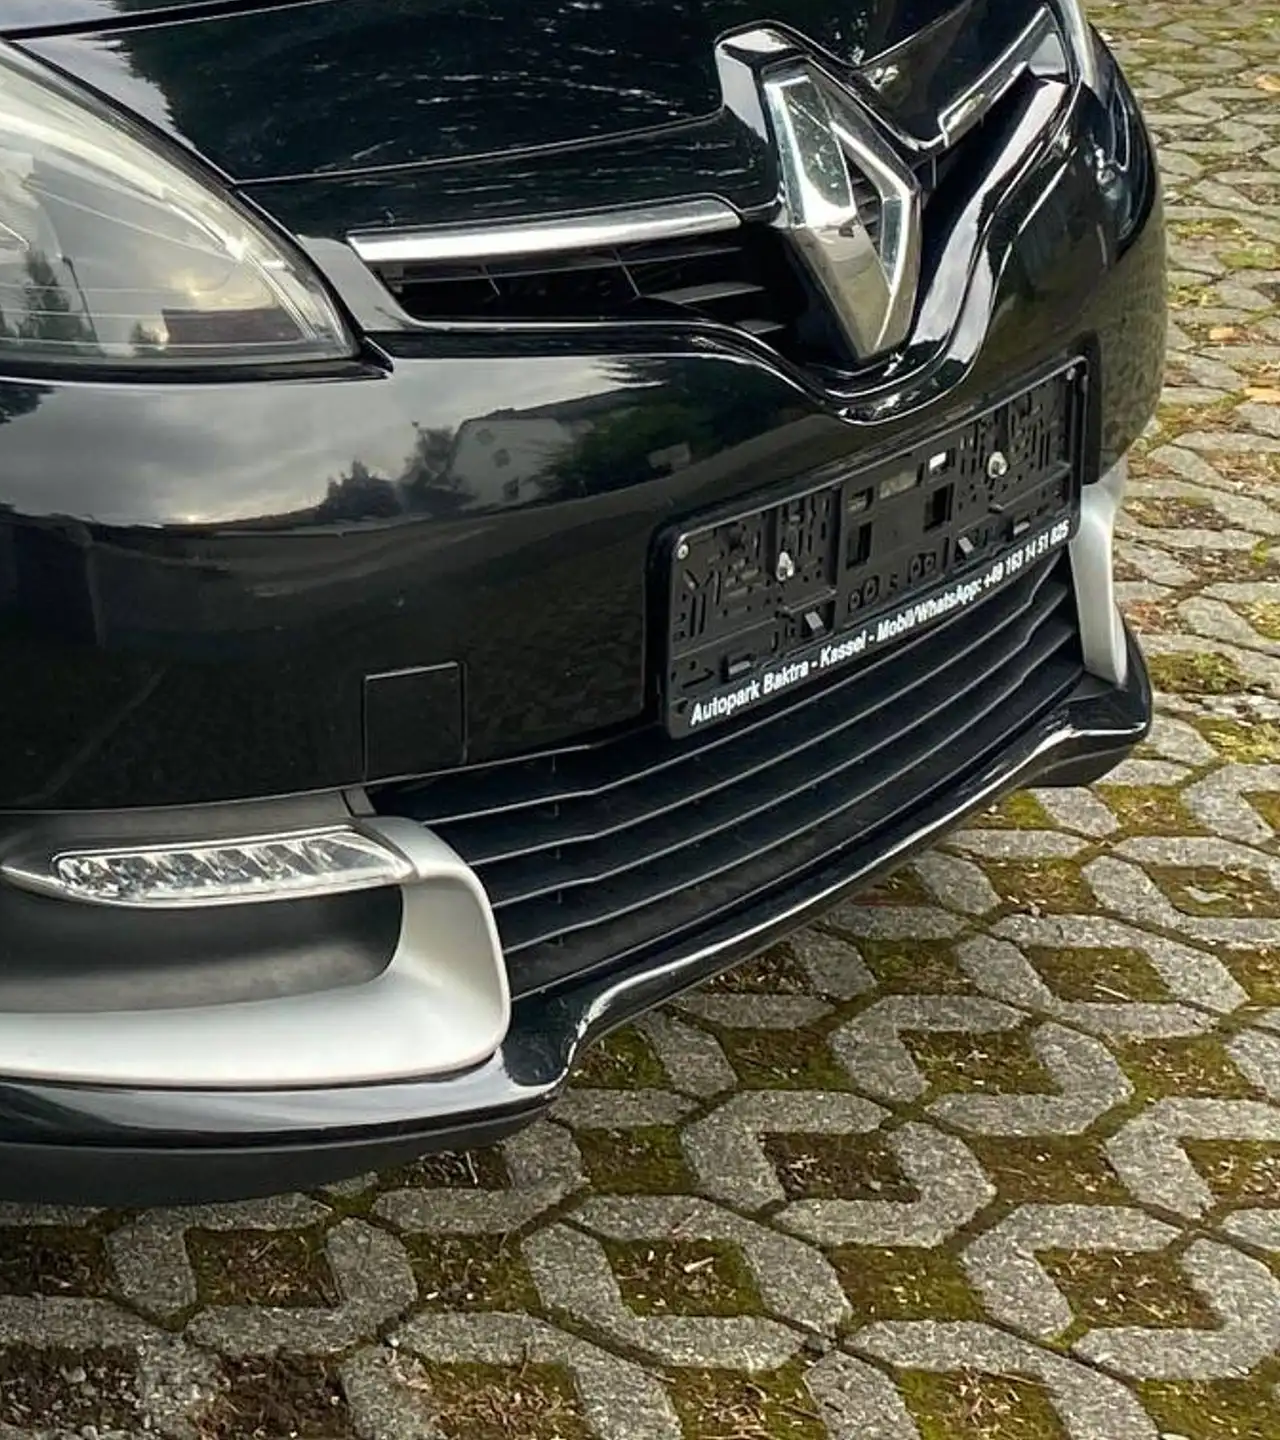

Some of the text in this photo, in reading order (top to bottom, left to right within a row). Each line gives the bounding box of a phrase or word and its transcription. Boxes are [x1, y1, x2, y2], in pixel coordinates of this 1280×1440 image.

[690, 679, 760, 727] Autopark
[763, 658, 809, 695] Baktra
[820, 629, 867, 668] Kassel
